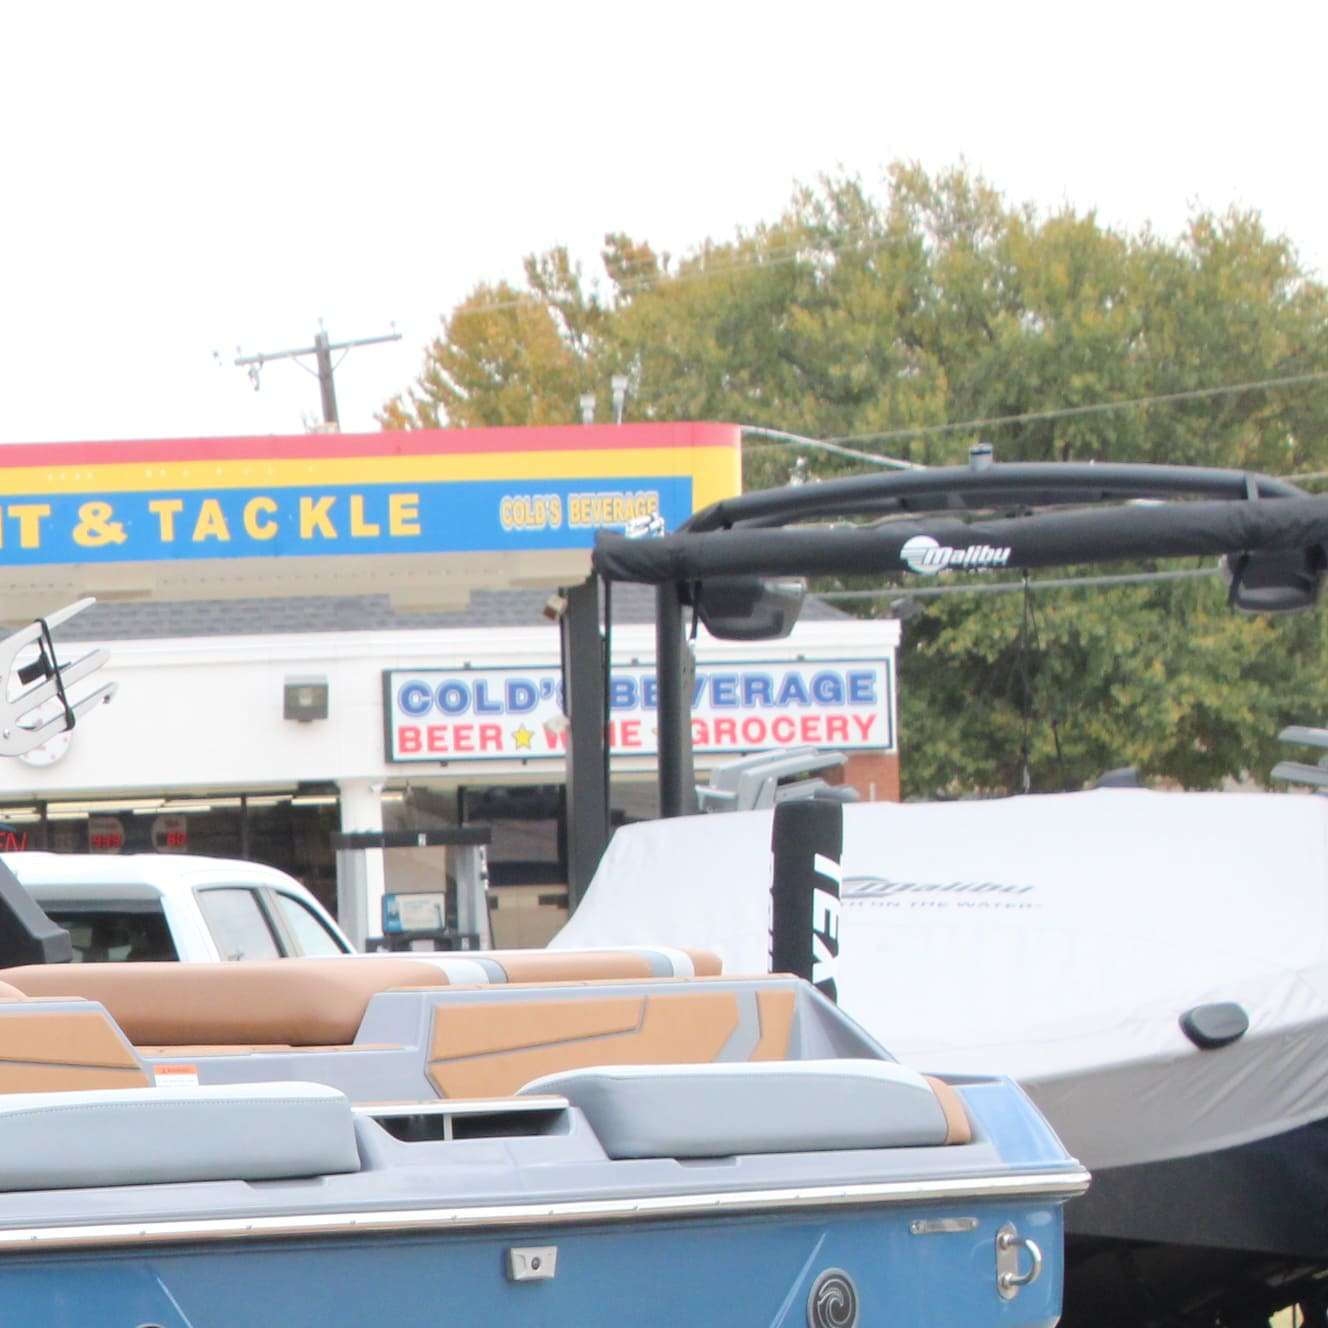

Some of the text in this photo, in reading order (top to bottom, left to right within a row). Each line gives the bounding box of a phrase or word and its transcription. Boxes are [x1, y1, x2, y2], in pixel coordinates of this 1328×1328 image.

[72, 501, 128, 546] &
[148, 493, 421, 542] TACKLE
[500, 490, 659, 530] COLD'S BEVERAGE
[398, 678, 565, 717] COLD'
[398, 722, 504, 753] BEER
[690, 713, 878, 747] GROCERY
